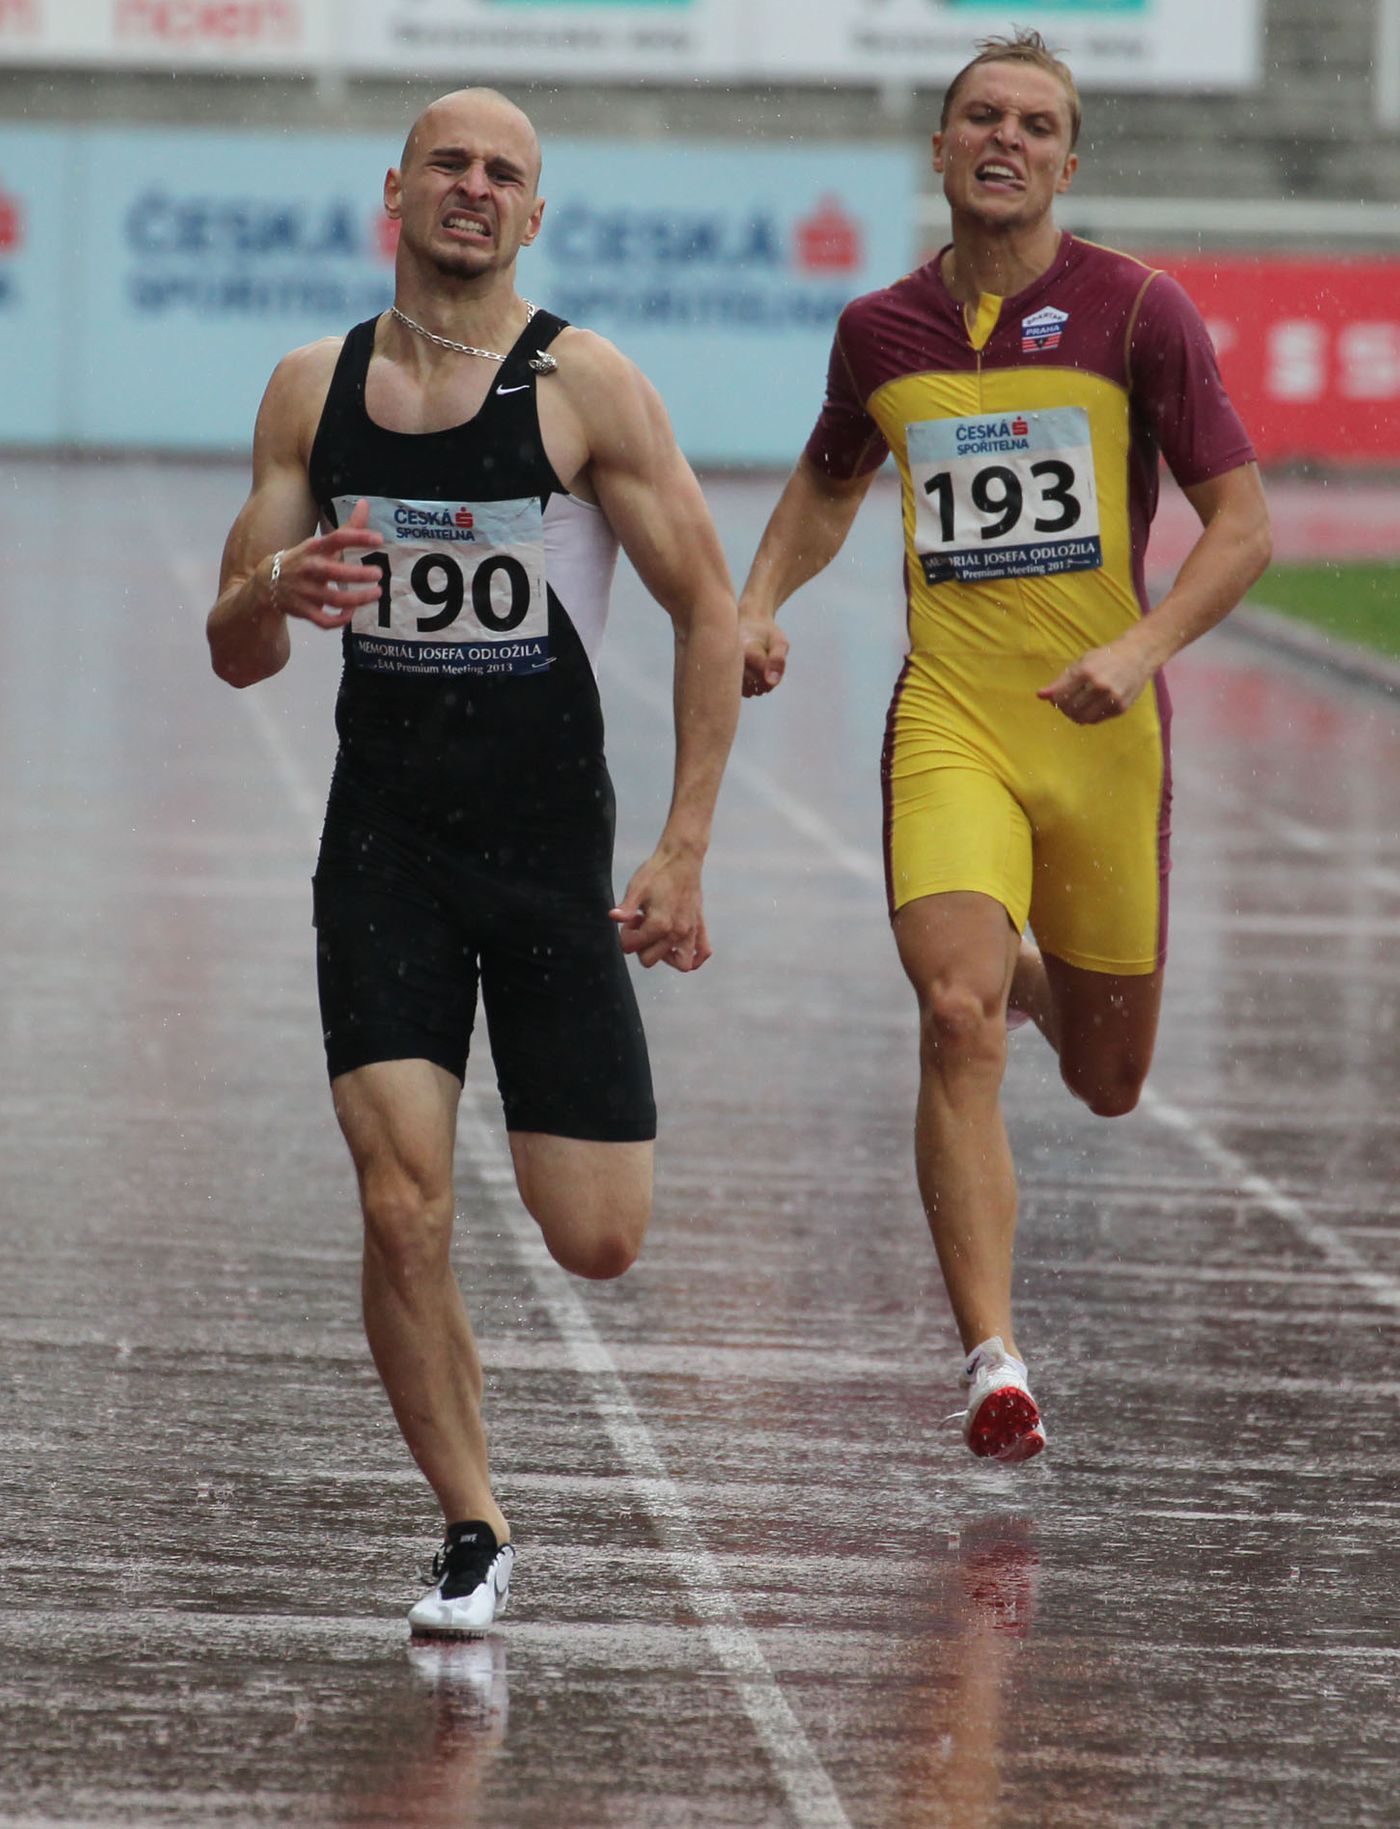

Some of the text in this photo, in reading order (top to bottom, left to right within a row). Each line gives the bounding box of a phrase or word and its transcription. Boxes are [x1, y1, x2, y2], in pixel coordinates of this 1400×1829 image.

[1026, 325, 1060, 336] PRAHA
[956, 419, 1011, 441] ČESKÁ
[957, 438, 1029, 456] SPOŘITELNA
[923, 459, 1081, 543] 193
[394, 506, 454, 527] ČESKÁ
[396, 526, 475, 541] SPOŘITELNA
[926, 542, 1095, 568] MERIÁL JOSEFA ODLOŽILA
[962, 566, 1005, 580] Premium
[1007, 562, 1046, 577] Meeting
[360, 551, 531, 632] 190
[358, 640, 542, 661] MEMORIÁL JOSEFA ODLOŽILA
[397, 661, 439, 674] Premium
[442, 663, 484, 676] Meeting
[486, 663, 513, 673] 2013
